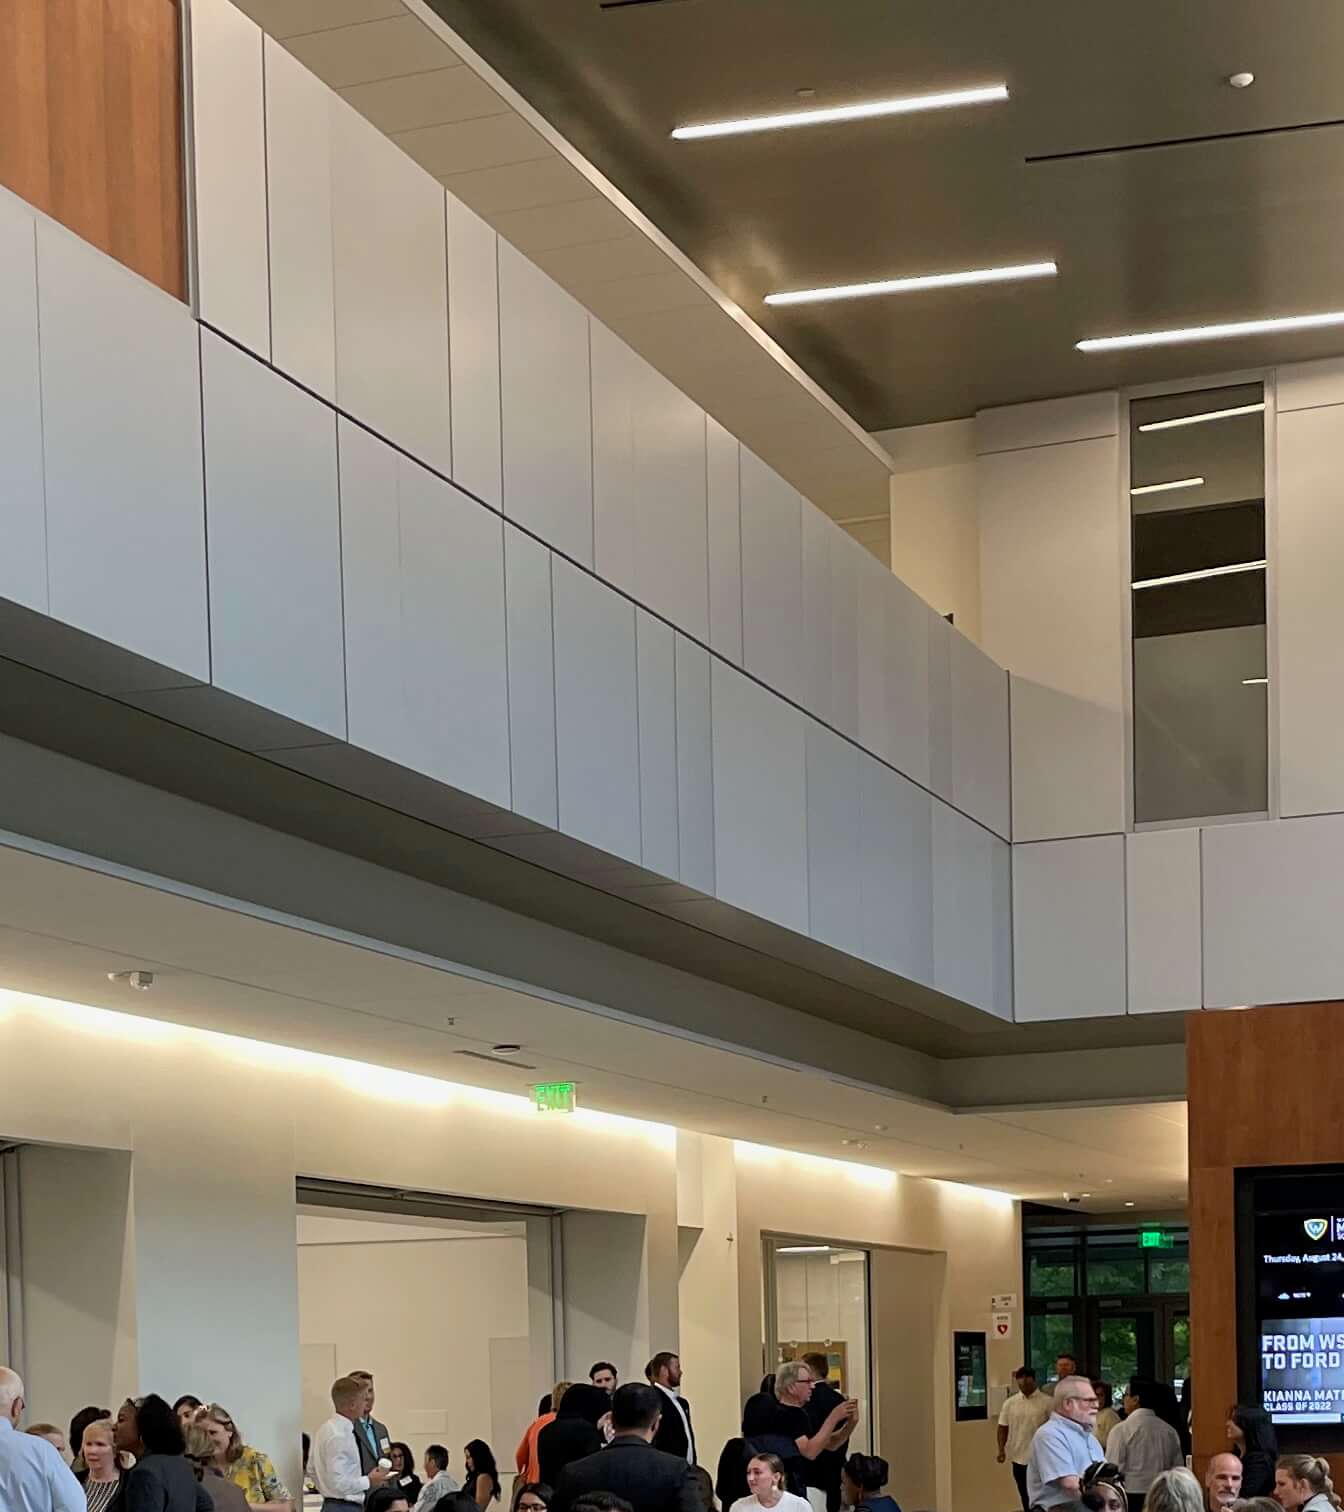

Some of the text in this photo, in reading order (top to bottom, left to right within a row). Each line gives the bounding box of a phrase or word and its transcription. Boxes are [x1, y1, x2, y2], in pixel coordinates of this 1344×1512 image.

[1264, 1254, 1301, 1263] Thursday,
[1302, 1253, 1330, 1263] August
[1262, 1334, 1314, 1351] FROM
[1262, 1351, 1340, 1369] TO FORD
[1263, 1389, 1310, 1402] KIANNA
[1263, 1401, 1332, 1412] CLASS OF 2022
